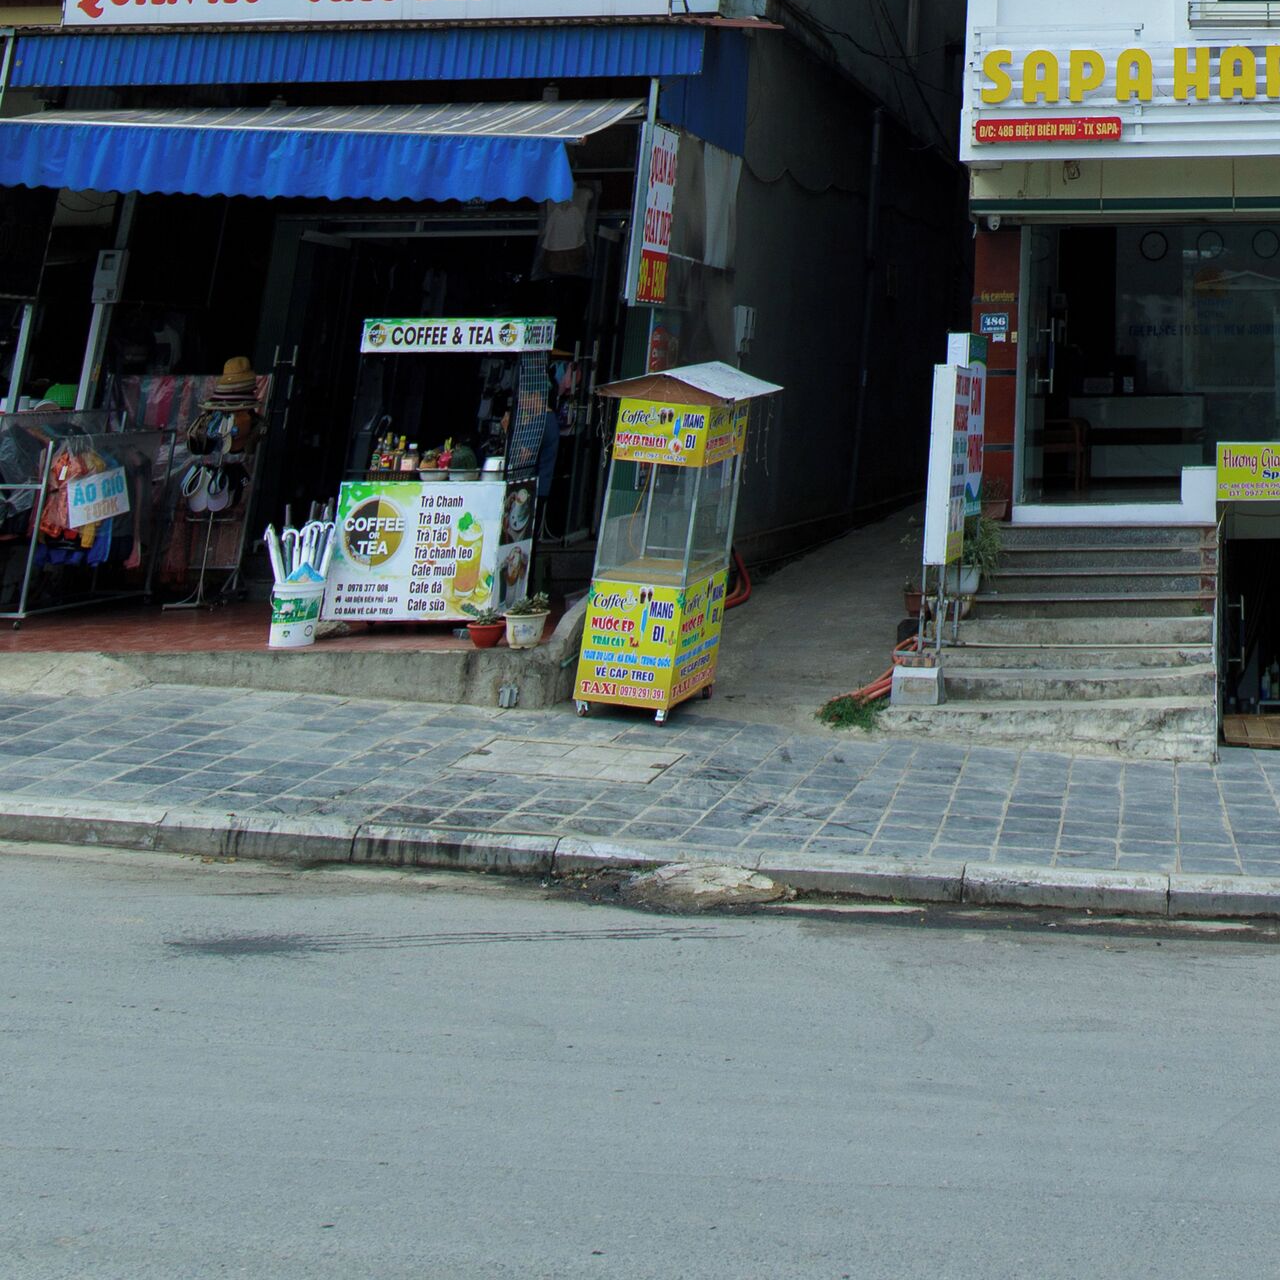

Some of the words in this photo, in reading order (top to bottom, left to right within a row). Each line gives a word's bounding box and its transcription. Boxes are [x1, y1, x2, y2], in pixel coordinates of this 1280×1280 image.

[981, 47, 1152, 104] SAPA
[983, 316, 1006, 326] 486
[391, 326, 447, 345] COFFEE
[452, 327, 463, 344] &
[469, 326, 494, 345] TEA
[621, 409, 651, 425] Coffee
[682, 413, 706, 429] MANG
[685, 433, 697, 449] ĐI
[73, 483, 97, 507] ÁO
[421, 495, 434, 507] Trà
[437, 495, 463, 508] Chanh
[344, 517, 405, 532] COFFEE
[419, 512, 432, 525] Trà
[434, 512, 451, 525] Đào
[417, 529, 430, 542] Trà
[357, 541, 388, 555] TEA
[414, 546, 427, 559] Trà
[430, 546, 456, 559] chanh
[459, 547, 473, 559] leo
[593, 593, 627, 610] Coffee
[650, 601, 674, 619] MANG
[652, 625, 664, 642] ĐI
[610, 667, 628, 679] CÁP
[631, 670, 655, 682] TREO
[581, 681, 617, 695] TAXI
